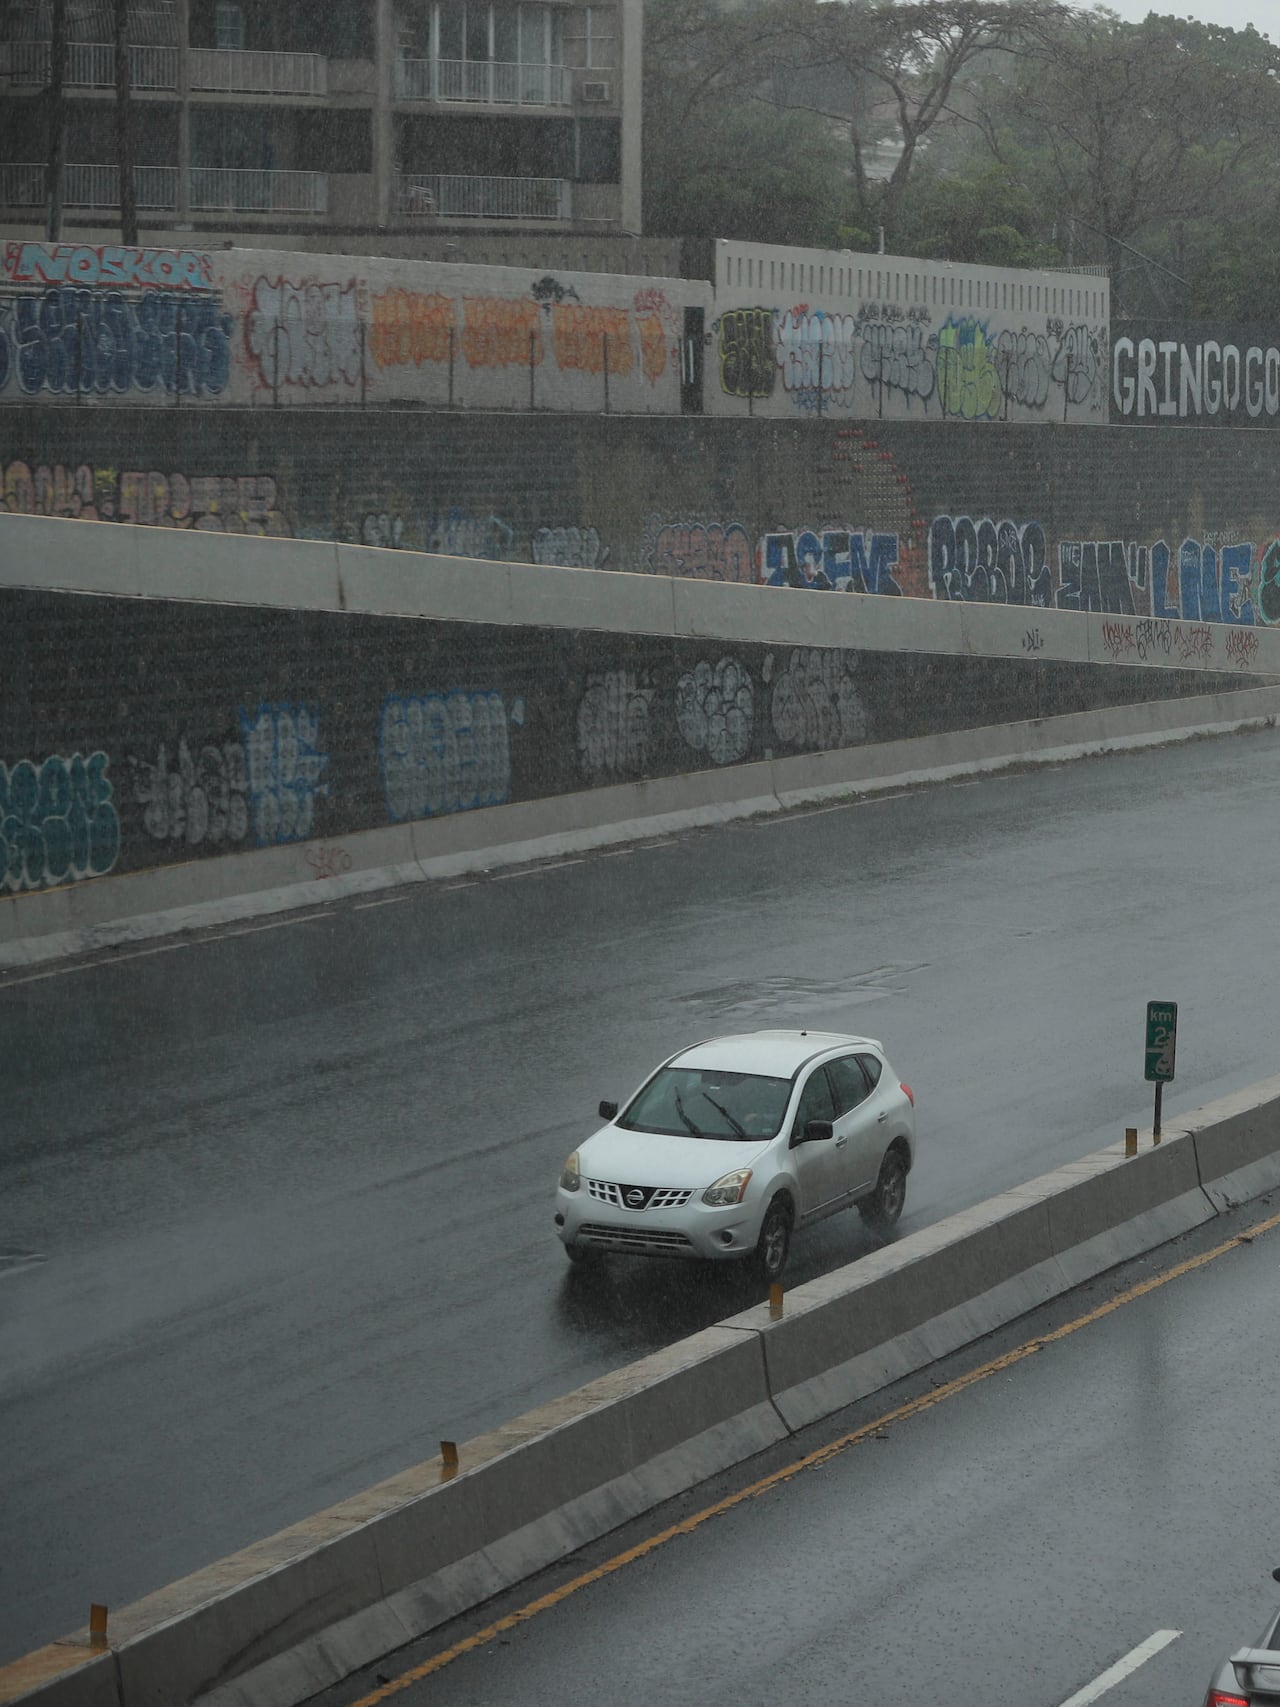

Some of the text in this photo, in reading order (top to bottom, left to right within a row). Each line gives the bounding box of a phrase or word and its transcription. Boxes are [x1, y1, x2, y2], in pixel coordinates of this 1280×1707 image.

[1113, 337, 1240, 417] GRINGO
[1246, 346, 1280, 417] GO
[1150, 1010, 1172, 1022] km
[1154, 1026, 1167, 1046] 2
